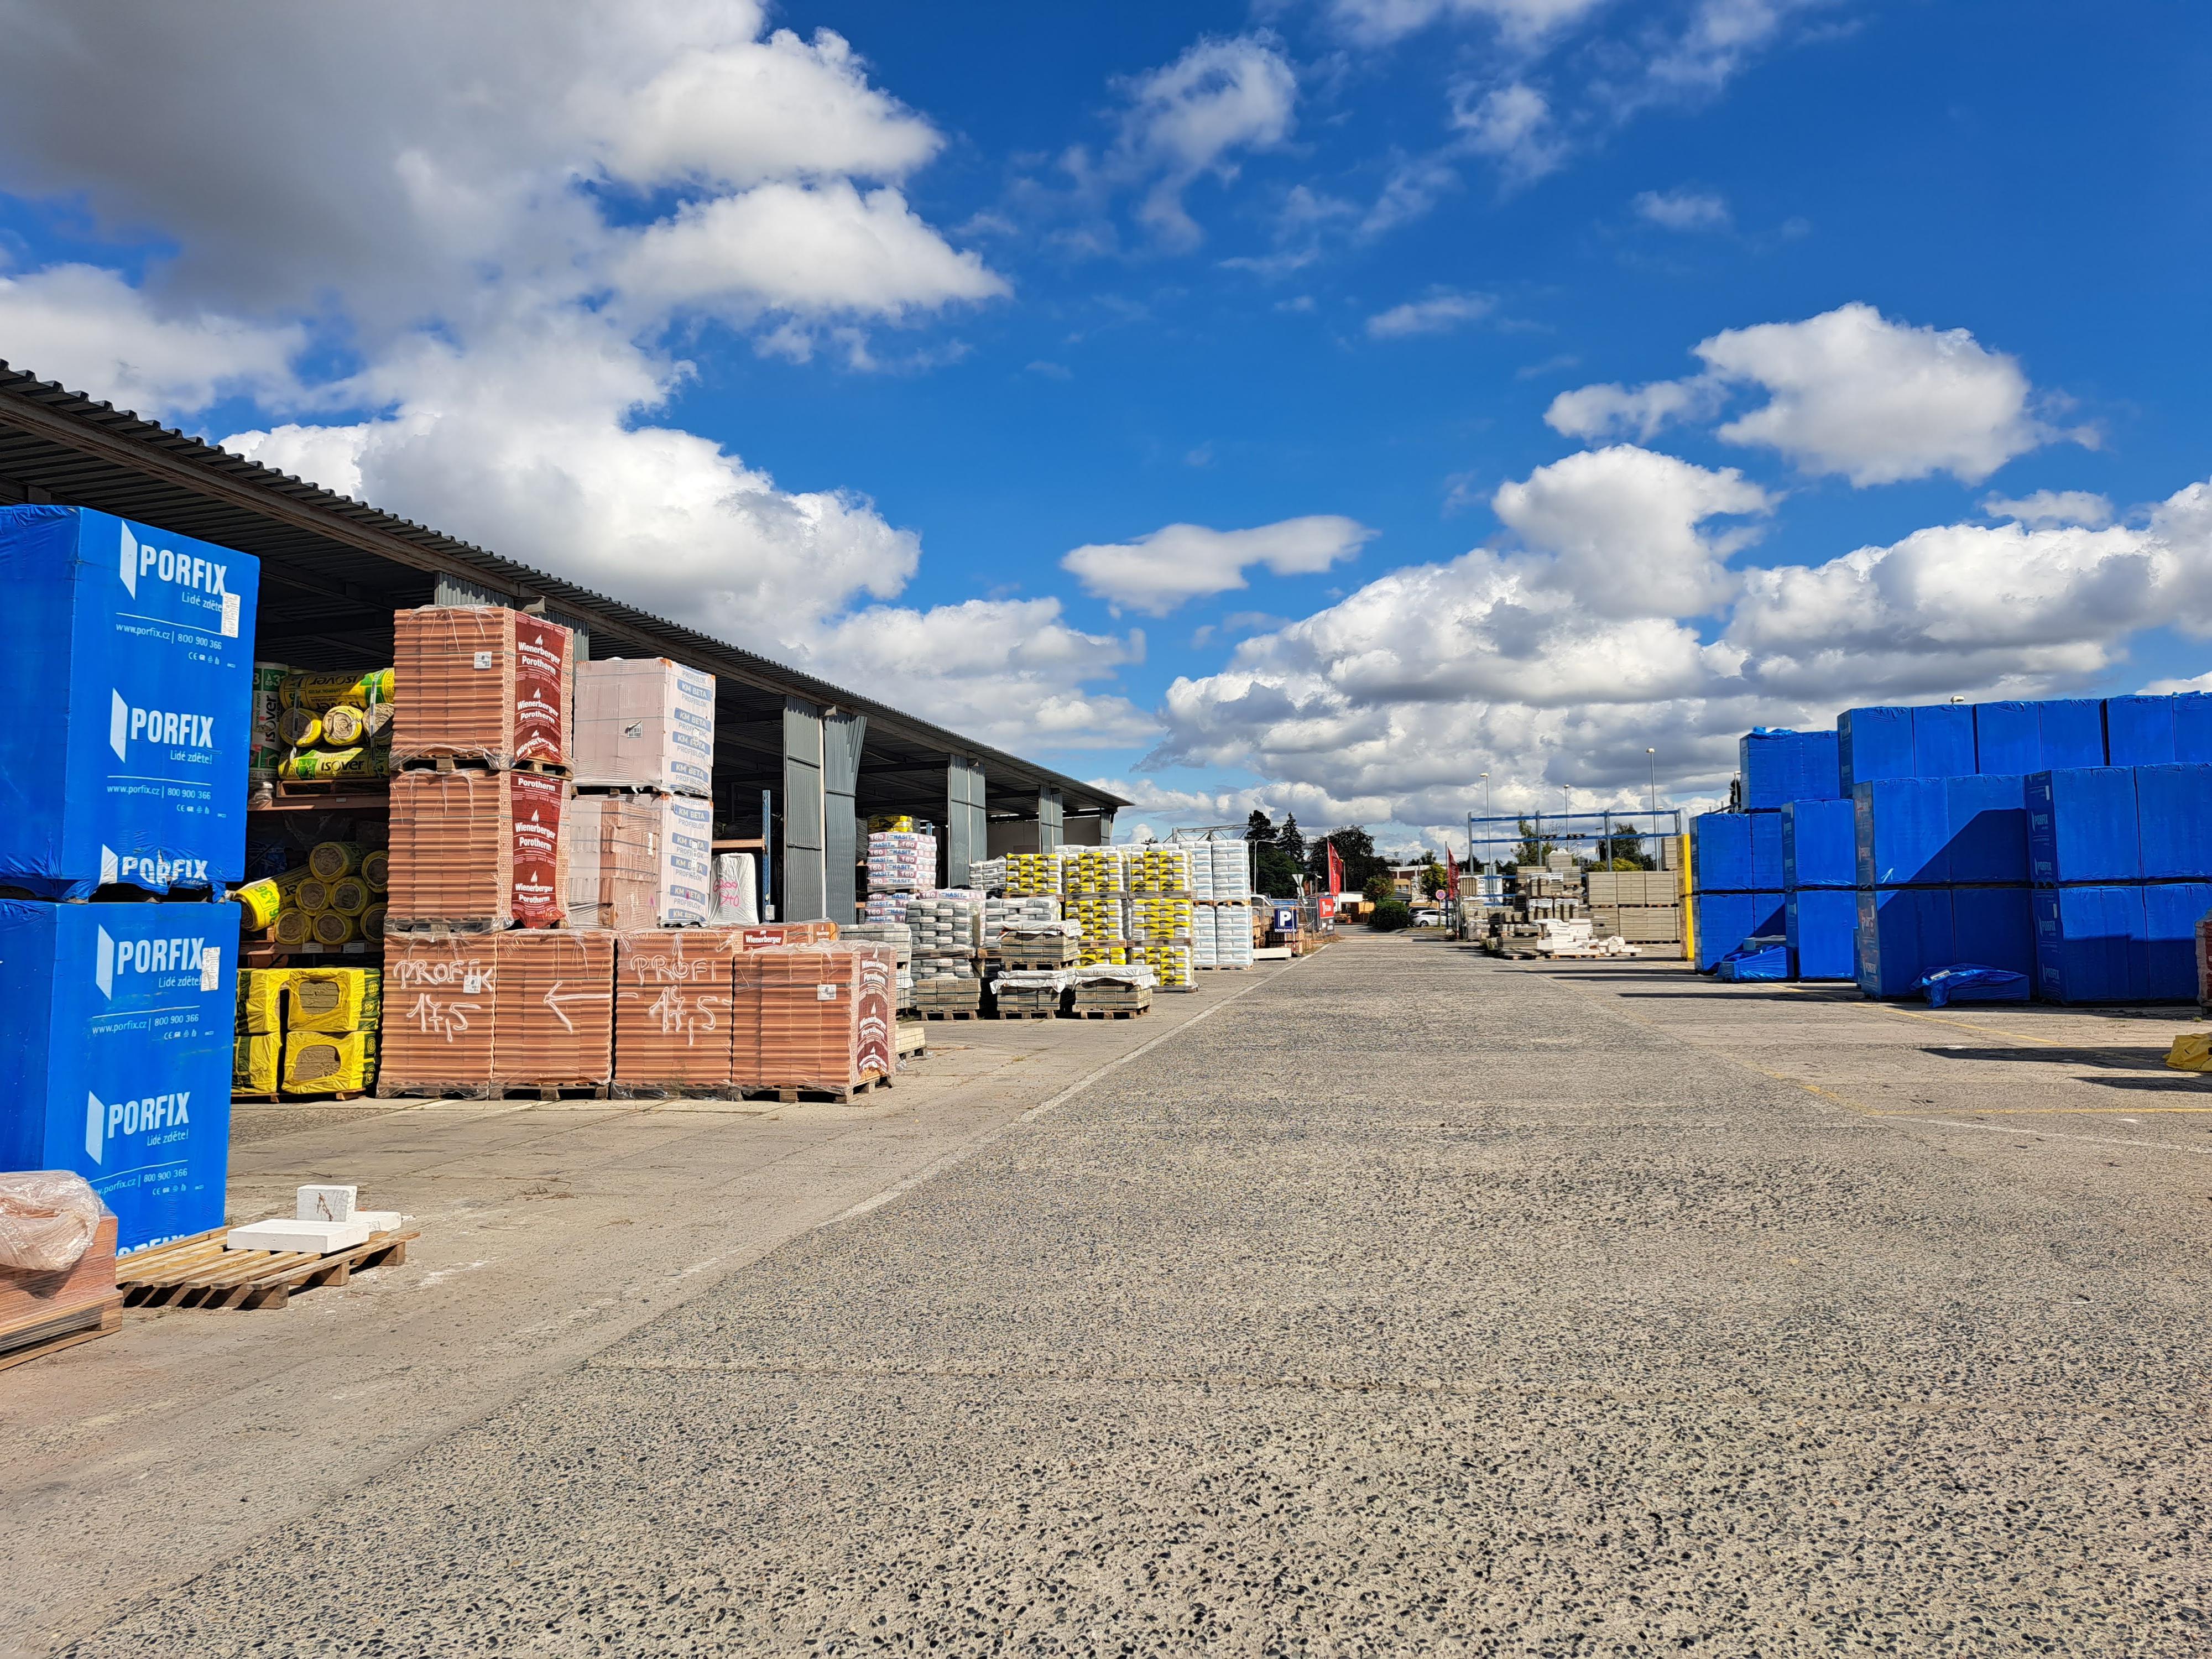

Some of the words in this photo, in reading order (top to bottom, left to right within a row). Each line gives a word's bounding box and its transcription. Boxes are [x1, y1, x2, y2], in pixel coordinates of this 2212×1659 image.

[140, 544, 227, 596] PORFIX
[182, 591, 201, 607] Lidé
[202, 600, 222, 613] zděte
[116, 623, 170, 640] www.porfix.cz
[178, 633, 193, 644] 800
[195, 636, 208, 647] 900
[210, 640, 222, 650] 366
[518, 641, 561, 665] Wienerberger
[521, 655, 556, 676] Porotherm
[681, 682, 691, 692] KM
[692, 687, 707, 698] BETA
[517, 699, 559, 718] Wienerberger
[681, 693, 707, 708] PROFIBLOK
[520, 712, 555, 724] Porotherm
[680, 711, 690, 721] KM
[692, 716, 707, 728] BETA
[131, 707, 214, 748] PORFIX
[677, 734, 688, 744] KM
[170, 749, 186, 761] Lidé
[187, 753, 213, 765] zděte!
[677, 744, 706, 761] PROFIBLOK
[676, 763, 687, 774] KM
[688, 766, 705, 780] BETA
[518, 777, 556, 791] Porotherm
[107, 785, 160, 795] www.porfix.cz
[168, 787, 180, 797] 800
[181, 789, 196, 799] 900
[197, 791, 211, 800] 366
[679, 807, 688, 817] KM
[690, 811, 706, 820] BETA
[515, 822, 556, 840] Wienerberger
[678, 817, 706, 830] PROFIBLOK
[519, 836, 552, 852] Porotherm
[677, 835, 687, 844] KM
[689, 838, 705, 850] BTA
[676, 847, 704, 859] PROFIOK
[675, 858, 686, 867] KM
[122, 856, 208, 886] PORFIX
[515, 883, 554, 893] Wienerberger
[674, 886, 684, 895] KM
[519, 894, 550, 902] Porotherm
[674, 897, 701, 910] PROFIBLOK
[1280, 910, 1292, 926] P
[745, 935, 782, 945] Wienerberger
[117, 937, 205, 975] PORFIX
[862, 959, 888, 973] Wienerberger
[159, 975, 177, 988] Lidé
[178, 975, 202, 987] zděte!
[863, 972, 886, 985] Porotherm
[93, 1020, 147, 1035] www.porfix.cz
[154, 1016, 168, 1027] 800
[170, 1014, 184, 1024] 900
[185, 1013, 199, 1022] 366
[108, 1091, 190, 1139] PORFIX
[147, 1134, 161, 1146] Lidé
[163, 1129, 189, 1144] zděte!
[144, 1173, 156, 1183] 800
[158, 1171, 171, 1181] 900
[173, 1168, 188, 1178] 366
